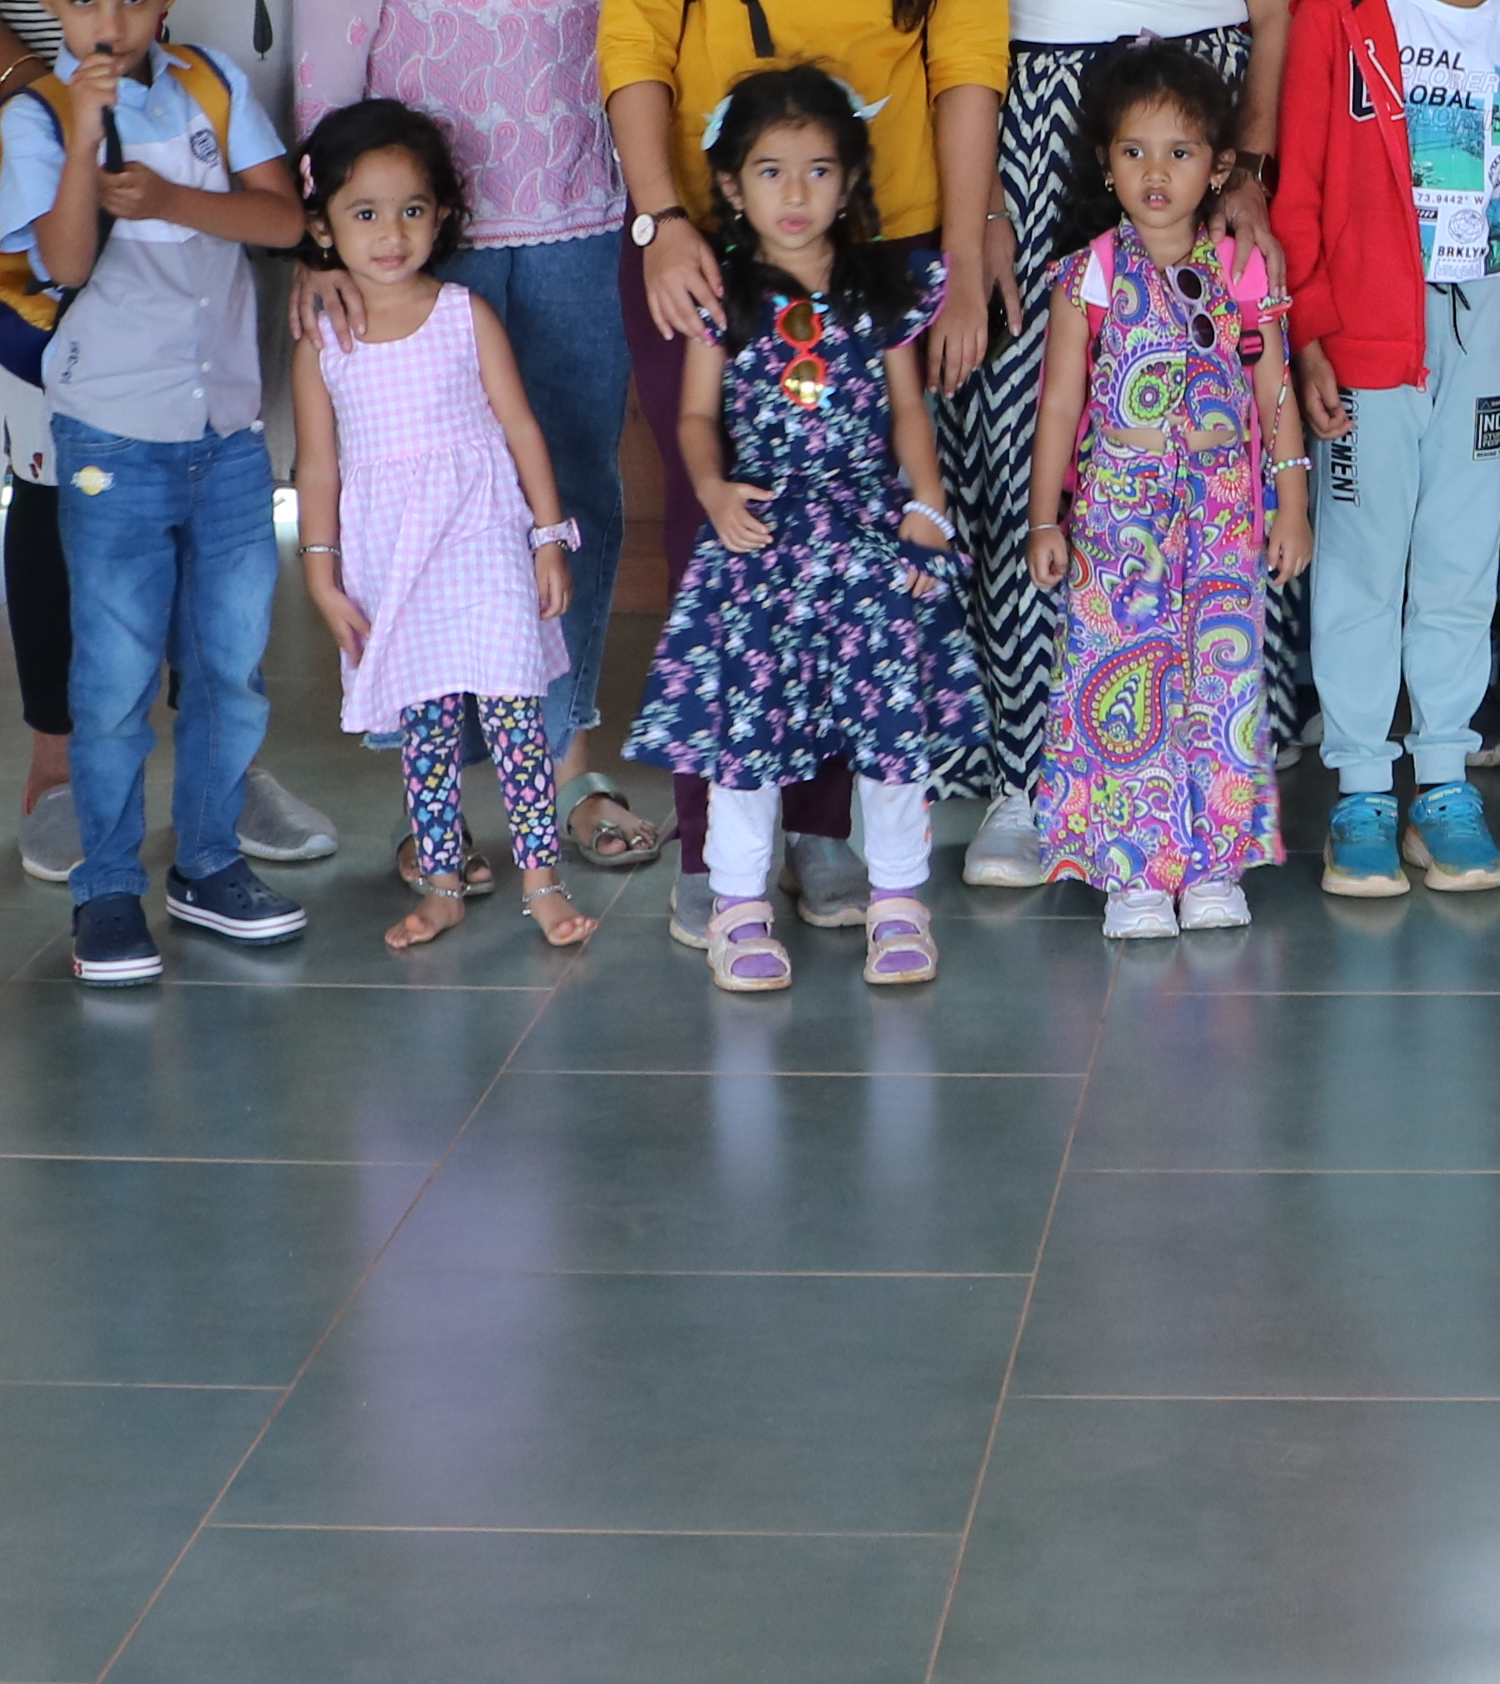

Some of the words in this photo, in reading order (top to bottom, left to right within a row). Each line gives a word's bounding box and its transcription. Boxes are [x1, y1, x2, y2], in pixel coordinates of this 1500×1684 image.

[1399, 45, 1465, 72] OBAL
[1401, 64, 1500, 94] PLORER
[1403, 85, 1477, 110] OBAL
[1474, 196, 1484, 205] W
[1331, 386, 1361, 507] OEMENT
